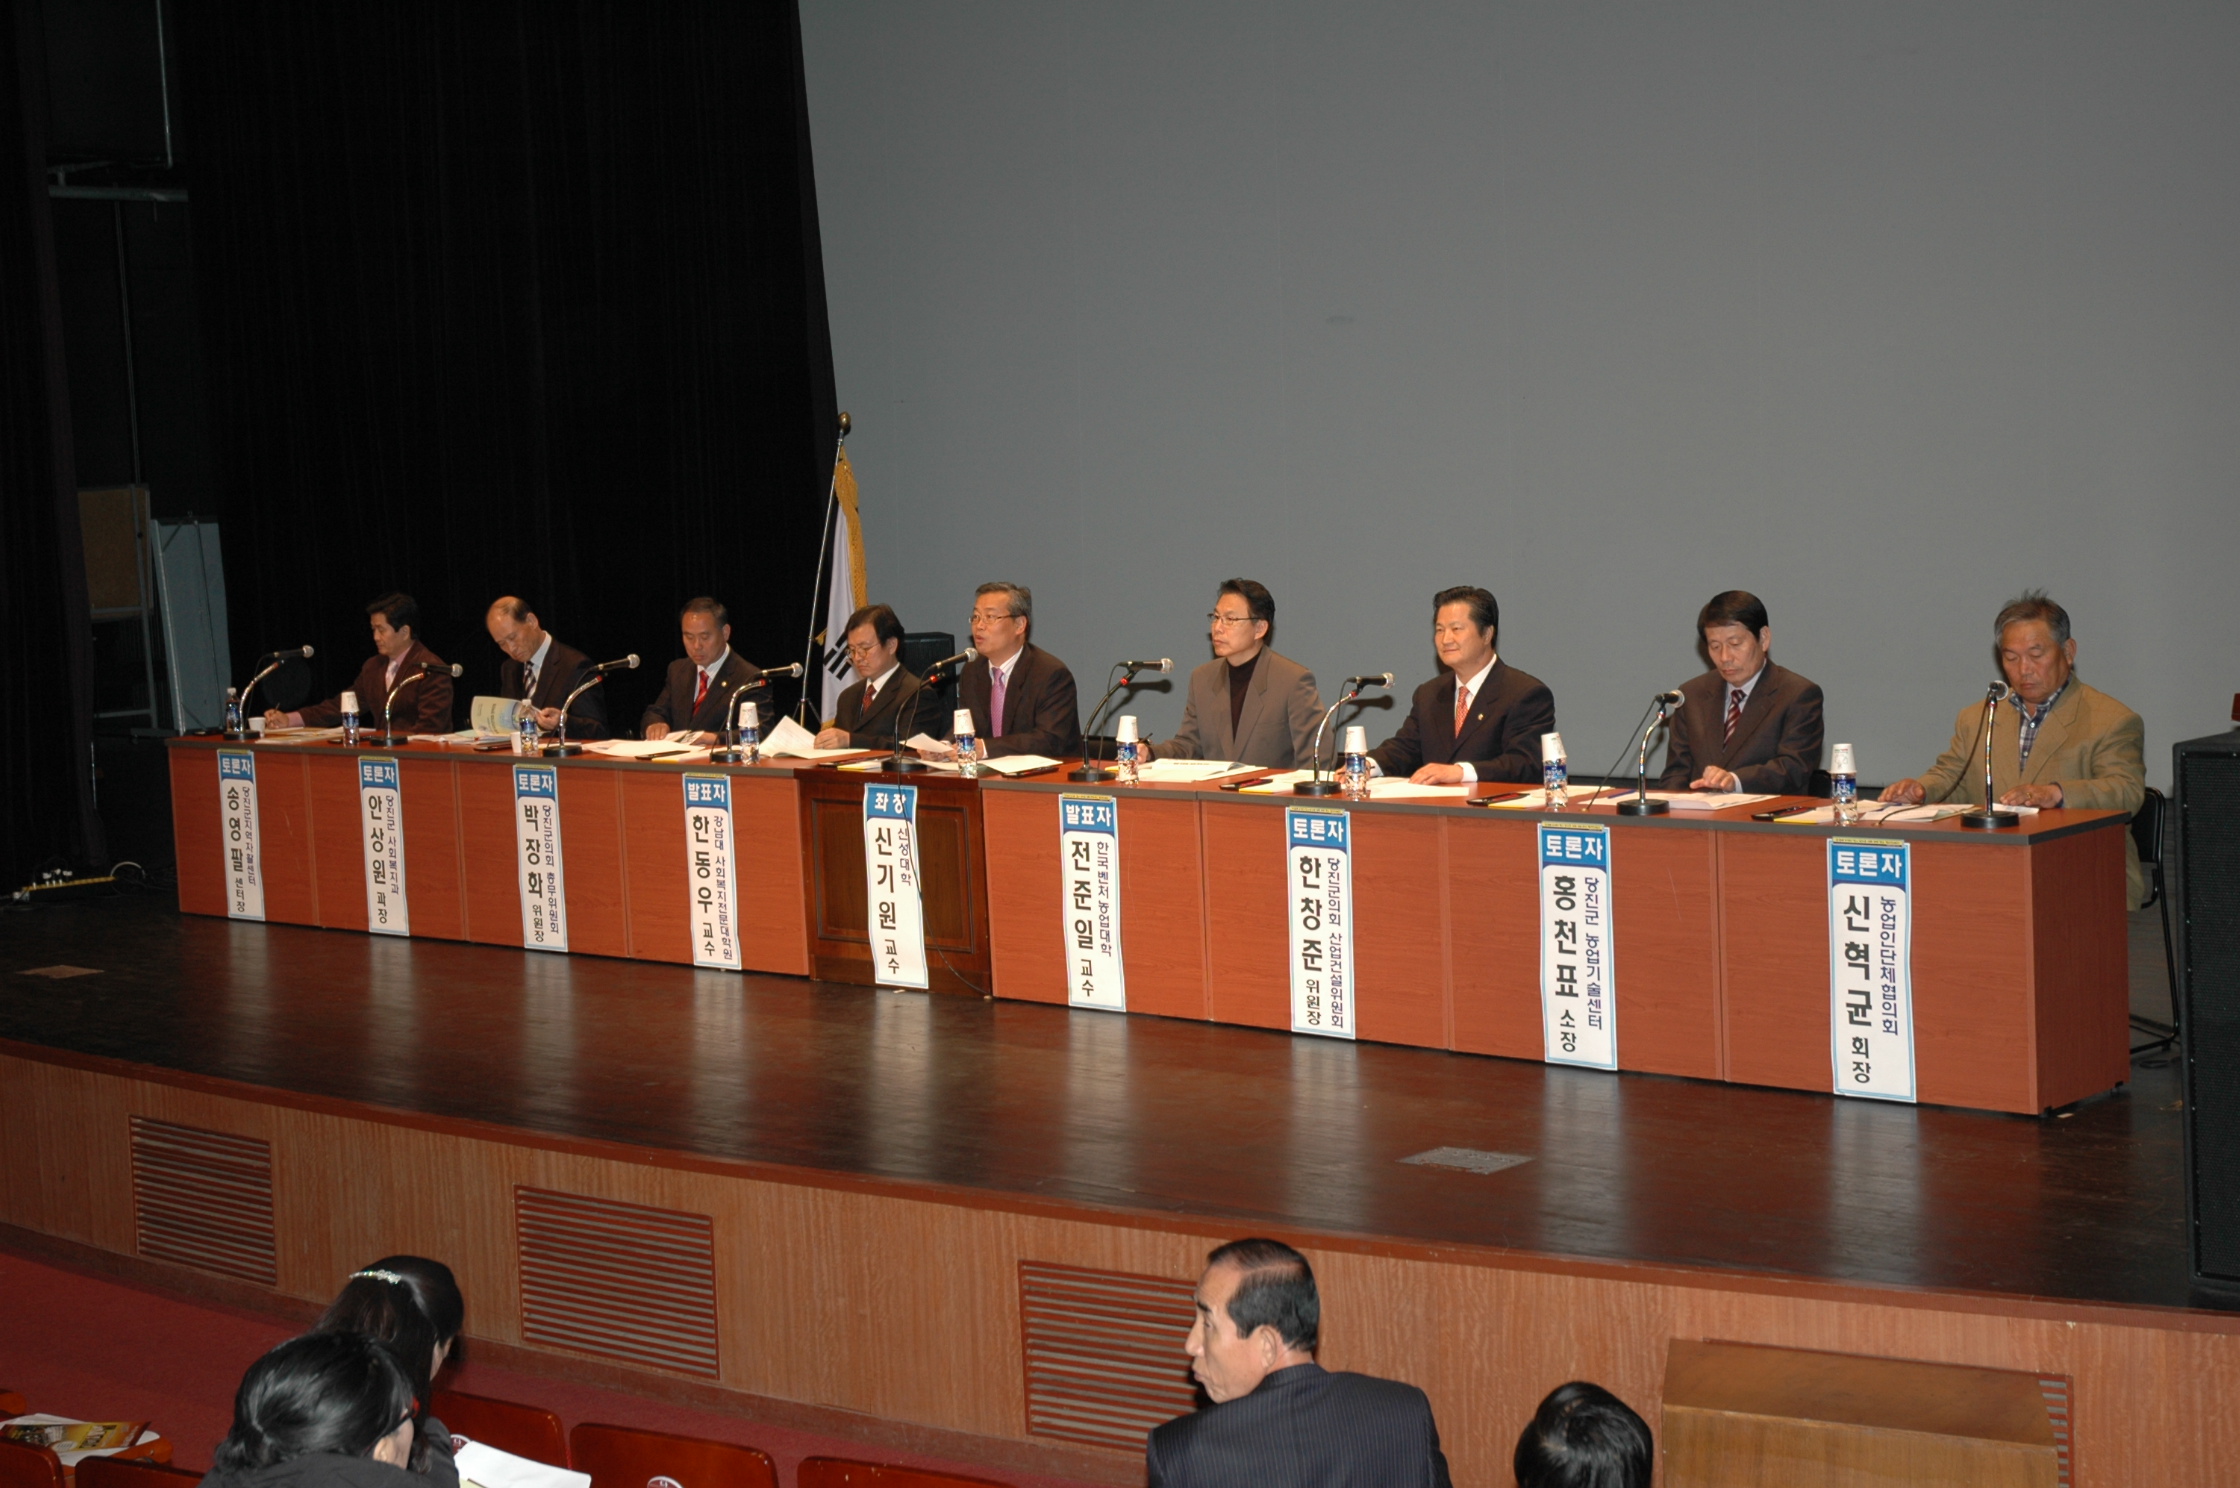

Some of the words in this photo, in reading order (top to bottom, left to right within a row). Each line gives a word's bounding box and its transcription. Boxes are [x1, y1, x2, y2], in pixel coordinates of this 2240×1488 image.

[222, 758, 251, 775] 토론자
[363, 765, 395, 783] 토론자
[519, 774, 553, 792] 토론자
[688, 783, 725, 802] 발표자
[874, 793, 906, 814] 좌장
[386, 796, 395, 831] 당진군
[1065, 804, 1112, 827] 발표자
[1293, 818, 1344, 842] 토론자
[542, 806, 554, 867] 당진군의회
[714, 816, 724, 851] 강남대
[1546, 835, 1603, 860] 토론자
[388, 836, 399, 895] 사회복지과
[898, 828, 911, 886] 신성대학
[1836, 851, 1901, 878] 토론자
[235, 878, 245, 913] 센터장
[377, 892, 387, 924] 과장
[547, 872, 559, 934] 총무위원회
[716, 856, 732, 960] 사회복지전문대학원
[1328, 858, 1341, 926] 당진군의회
[1585, 877, 1599, 926] 당진군
[532, 904, 544, 942] 위원장
[703, 922, 715, 956] 교수
[885, 939, 899, 974] 교수
[1880, 896, 1898, 1036] 농업인단체협의회
[1081, 958, 1094, 997] 교수
[1329, 932, 1343, 1028] 산업건설위원회
[1586, 932, 1602, 1030] 농업기술센터
[1306, 979, 1321, 1026] 위원장
[1560, 1009, 1577, 1053] 소장
[1852, 1037, 1871, 1084] 회장
